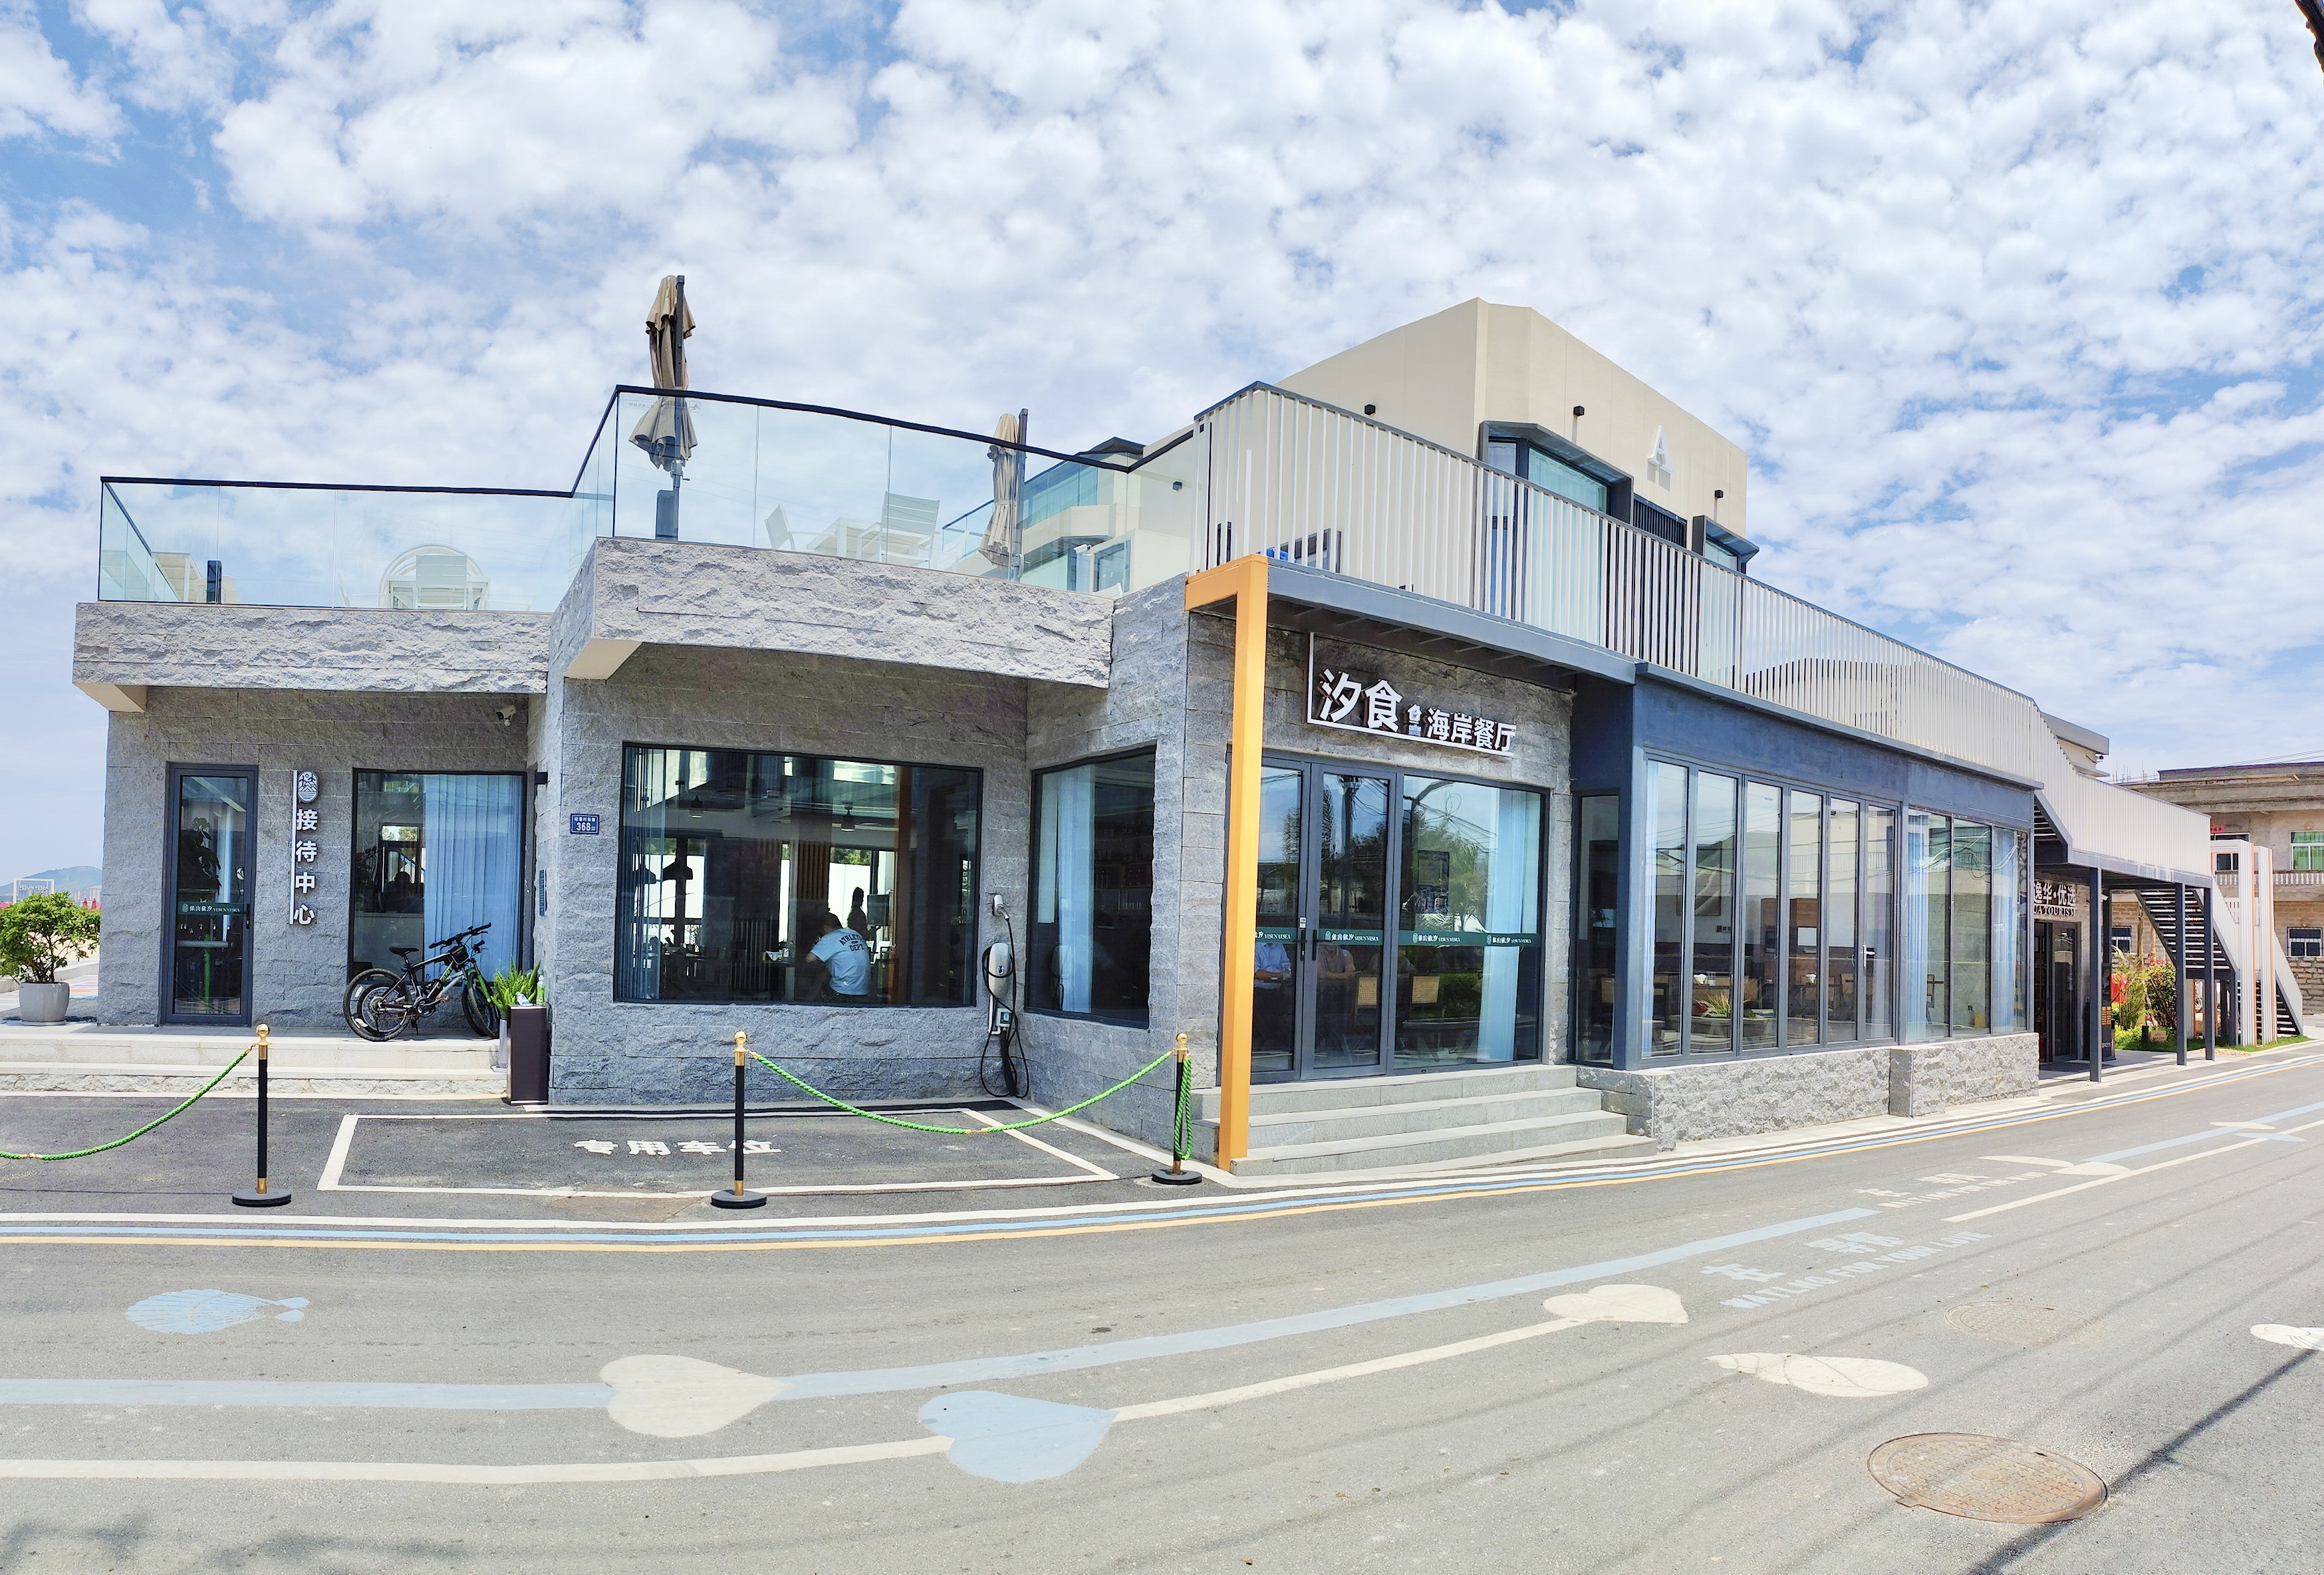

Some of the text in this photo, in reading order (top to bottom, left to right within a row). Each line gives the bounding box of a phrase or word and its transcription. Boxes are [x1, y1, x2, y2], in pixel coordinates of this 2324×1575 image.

[1646, 425, 1672, 474] A
[1320, 668, 1517, 752] 汐食 海岸餐厅
[577, 822, 590, 831] 368
[293, 809, 318, 925] 接待中心
[2043, 906, 2075, 917] TOURISM
[573, 1139, 782, 1155] 专用车位
[1825, 1261, 1890, 1278] FOR
[1873, 1245, 1944, 1263] YOUR
[1928, 1231, 1994, 1249] LOVE
